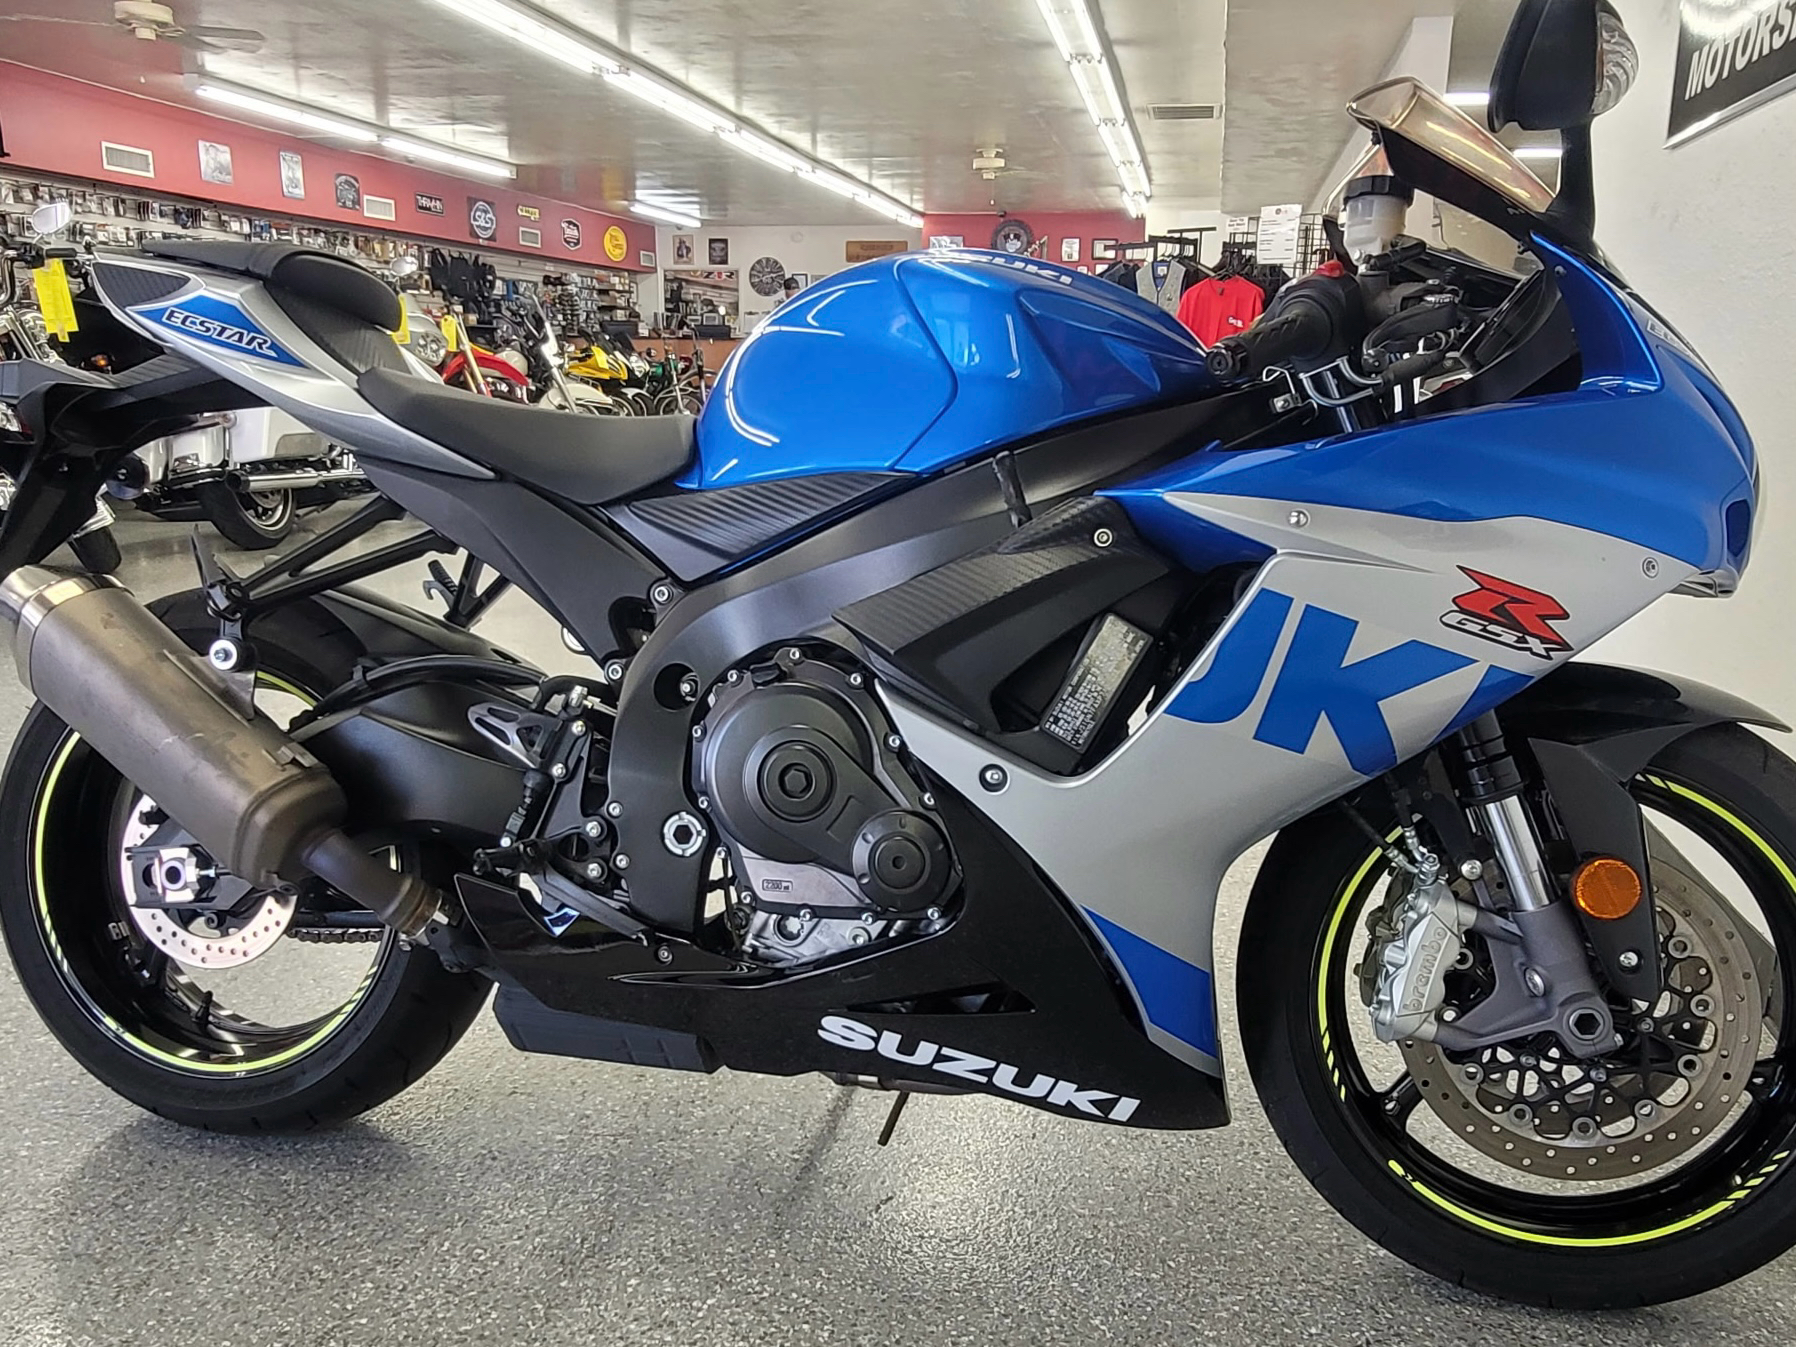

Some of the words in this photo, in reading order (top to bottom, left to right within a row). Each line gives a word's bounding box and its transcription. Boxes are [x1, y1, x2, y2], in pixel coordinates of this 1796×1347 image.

[1684, 0, 1796, 101] MOTORS
[163, 307, 277, 357] ECSTAR
[1440, 610, 1564, 660] GSX
[1402, 926, 1448, 1012] brembo
[817, 1015, 1141, 1122] SUZUKI
